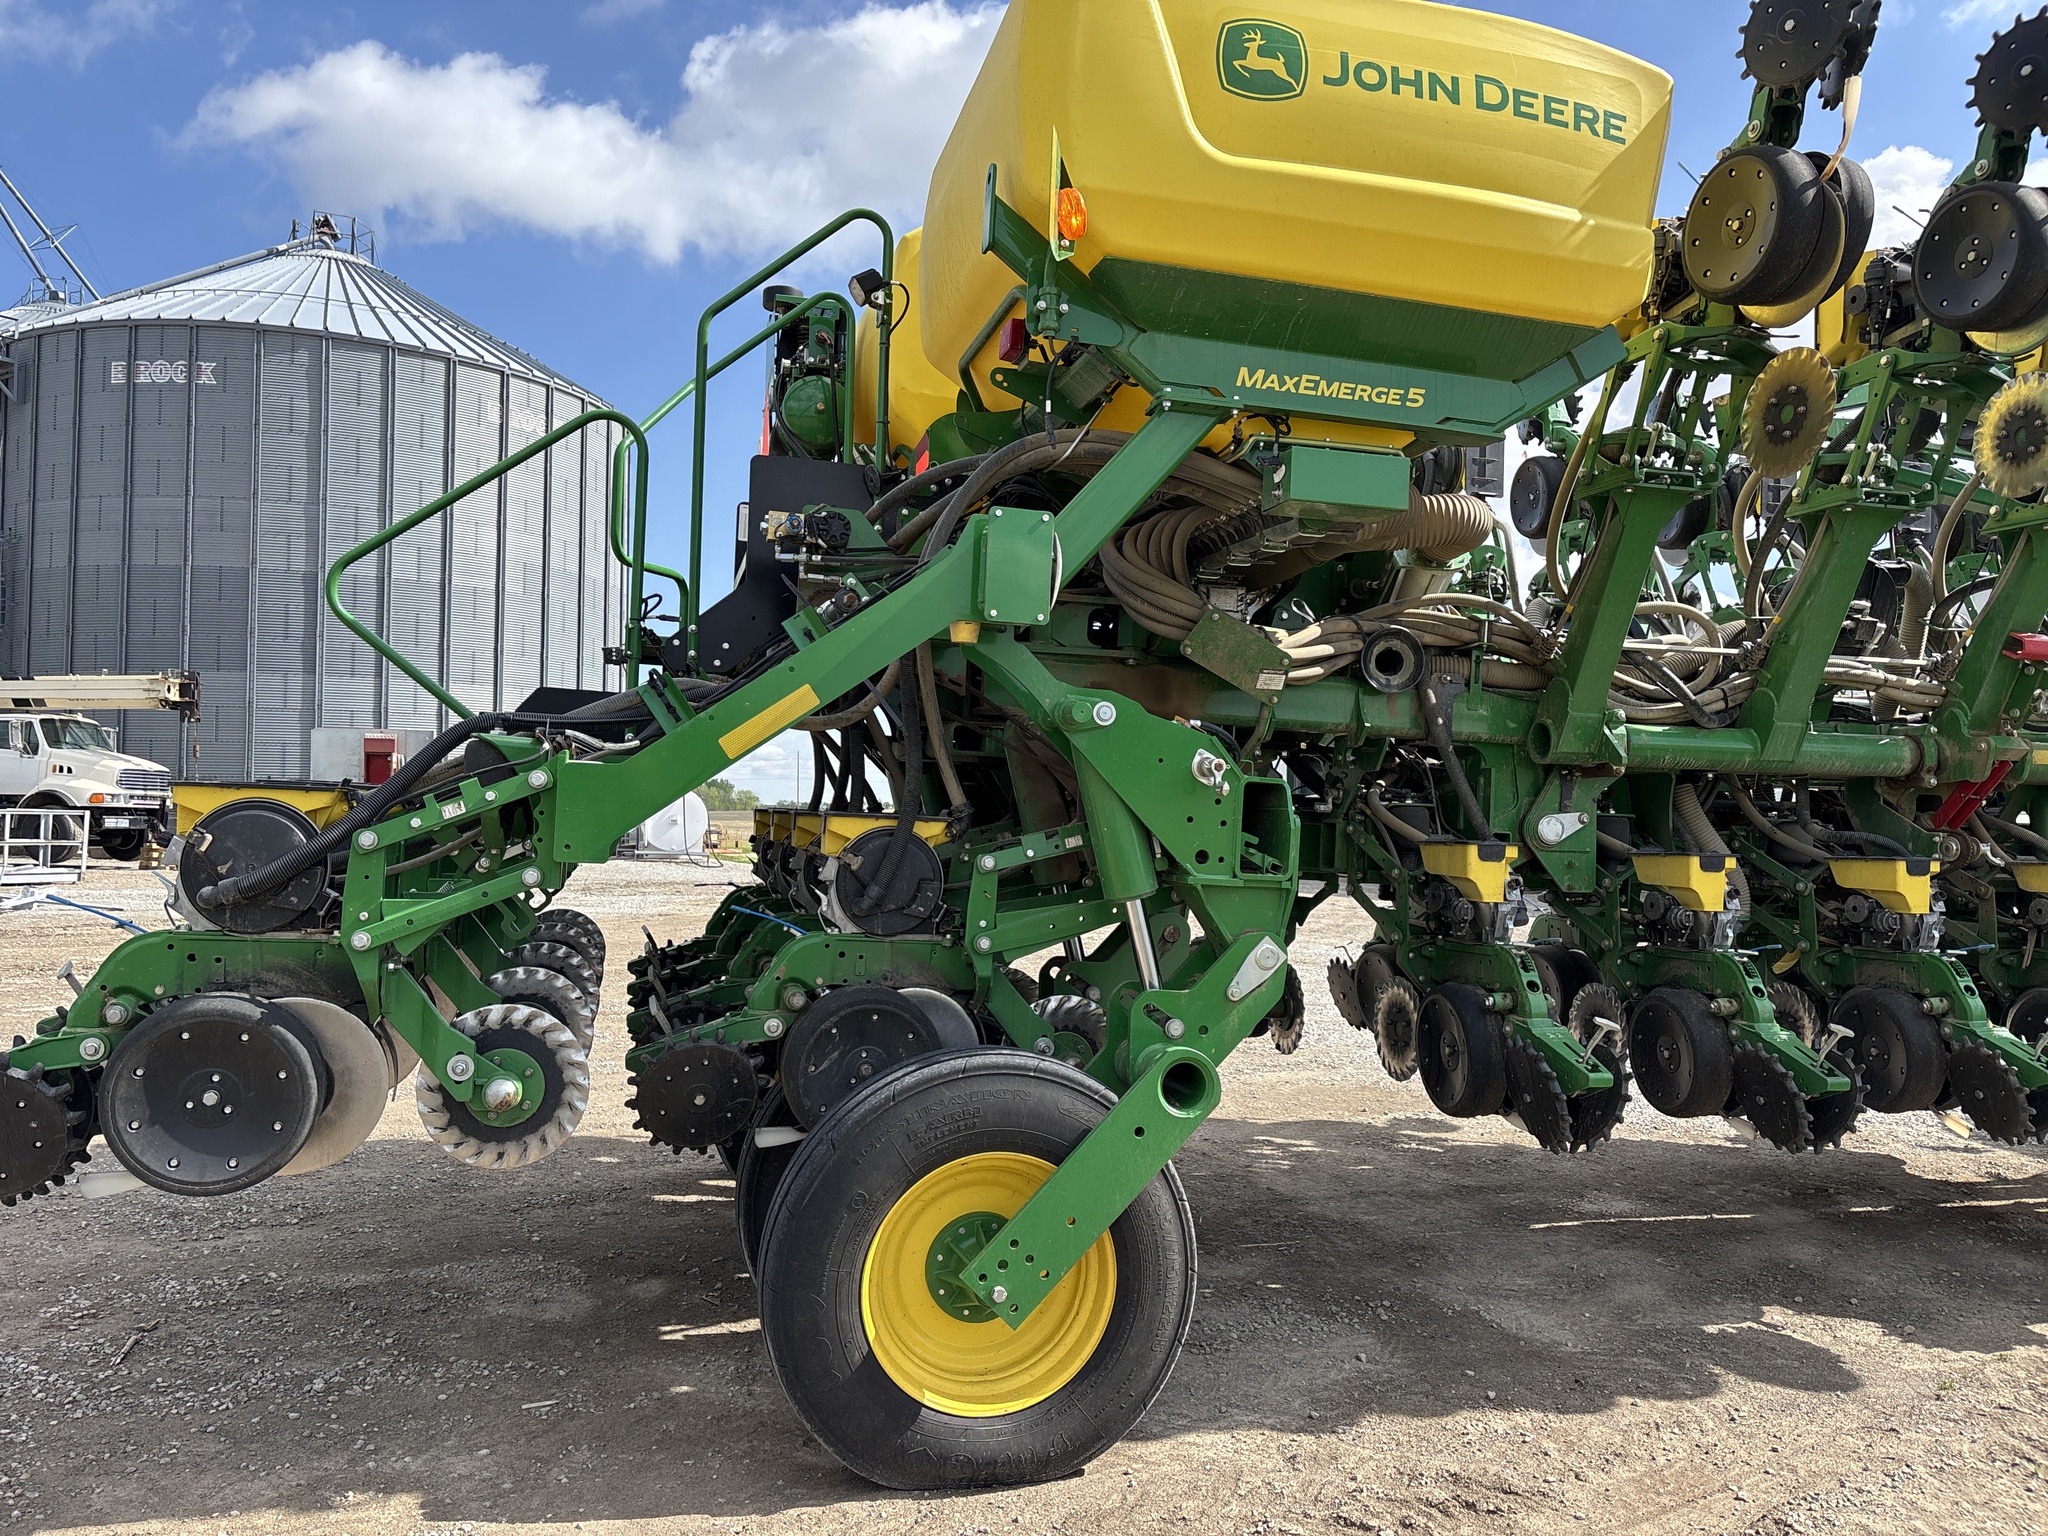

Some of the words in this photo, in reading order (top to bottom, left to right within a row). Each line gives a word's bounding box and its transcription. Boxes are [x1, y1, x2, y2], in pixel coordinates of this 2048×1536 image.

[1323, 51, 1460, 105] JOHN
[1474, 74, 1627, 145] DEERE
[110, 360, 217, 384] BROCK
[1148, 1181, 1181, 1353] 295/75R22.5
